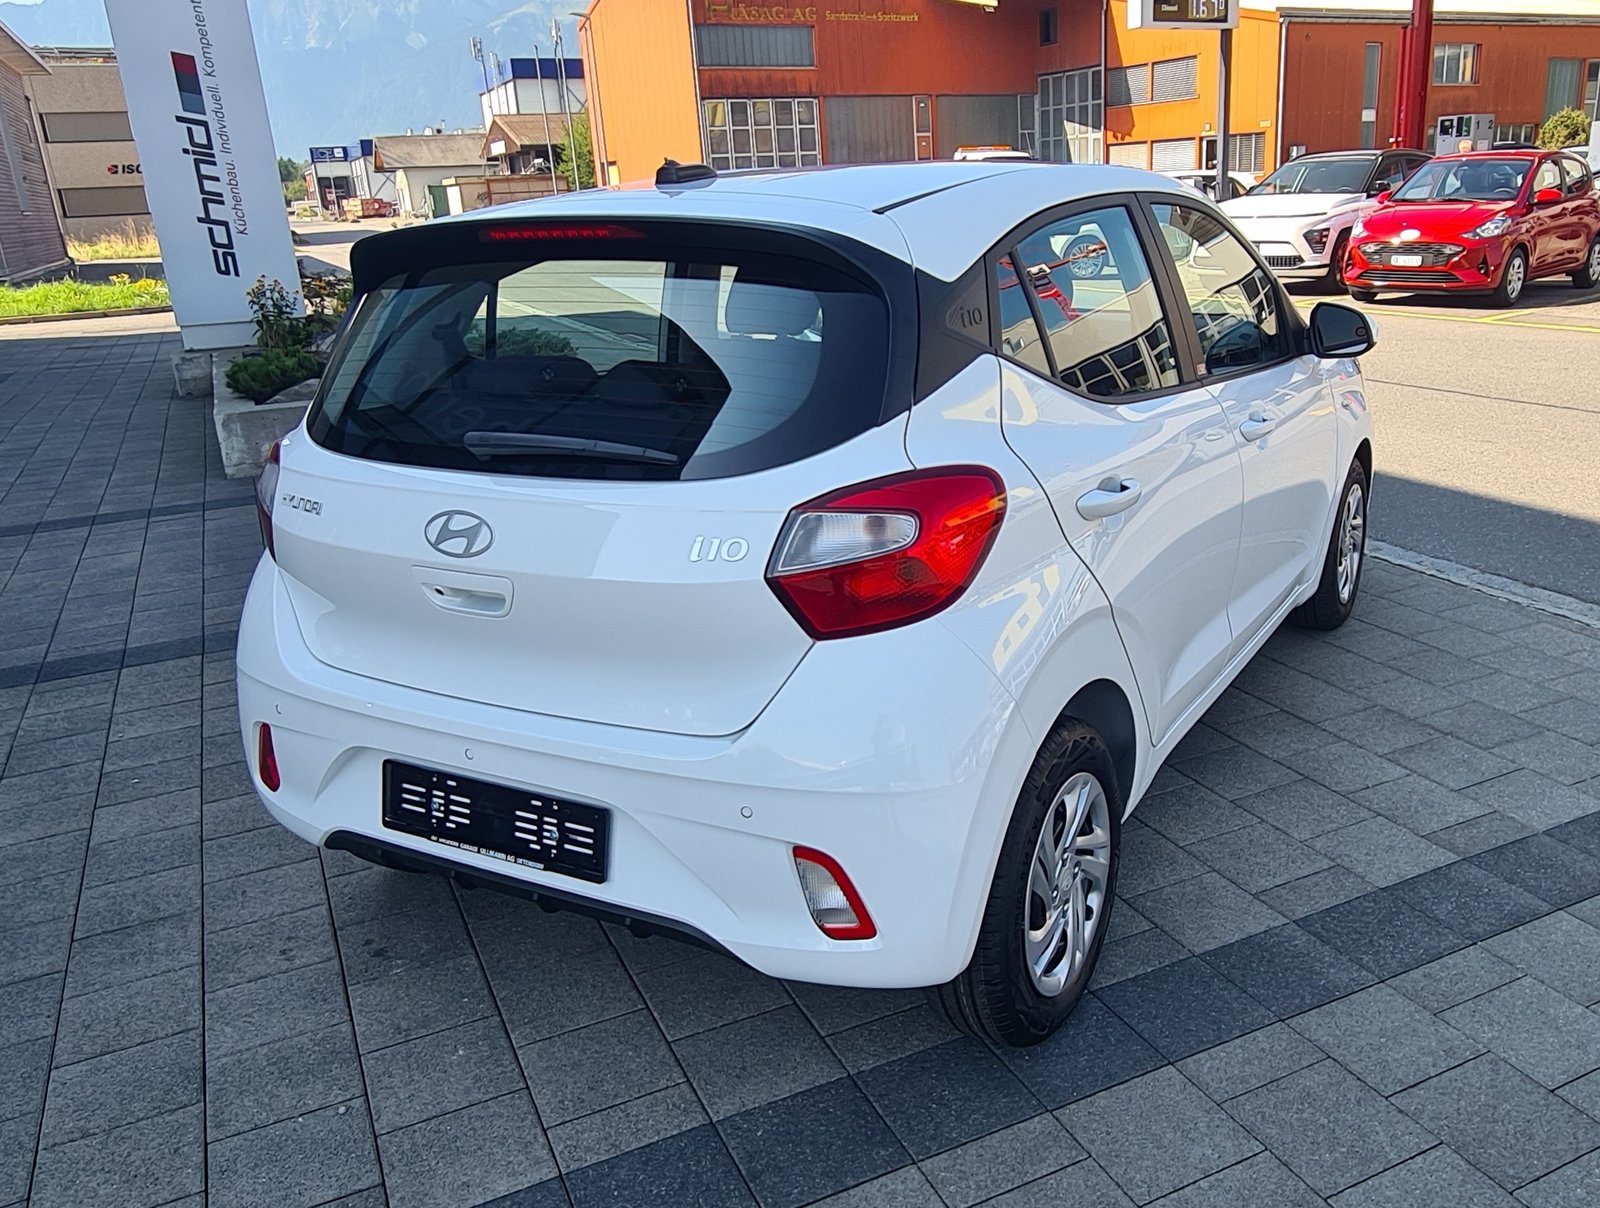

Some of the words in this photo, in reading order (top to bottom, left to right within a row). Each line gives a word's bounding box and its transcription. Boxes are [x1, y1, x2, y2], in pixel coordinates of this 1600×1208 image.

[792, 7, 817, 21] AG
[206, 83, 232, 154] Individuell.
[1476, 120, 1480, 130] 1
[1488, 120, 1494, 130] 2
[175, 115, 240, 278] schmid
[225, 159, 249, 236] Küchenbau.
[960, 305, 983, 329] i10
[688, 535, 750, 563] i10
